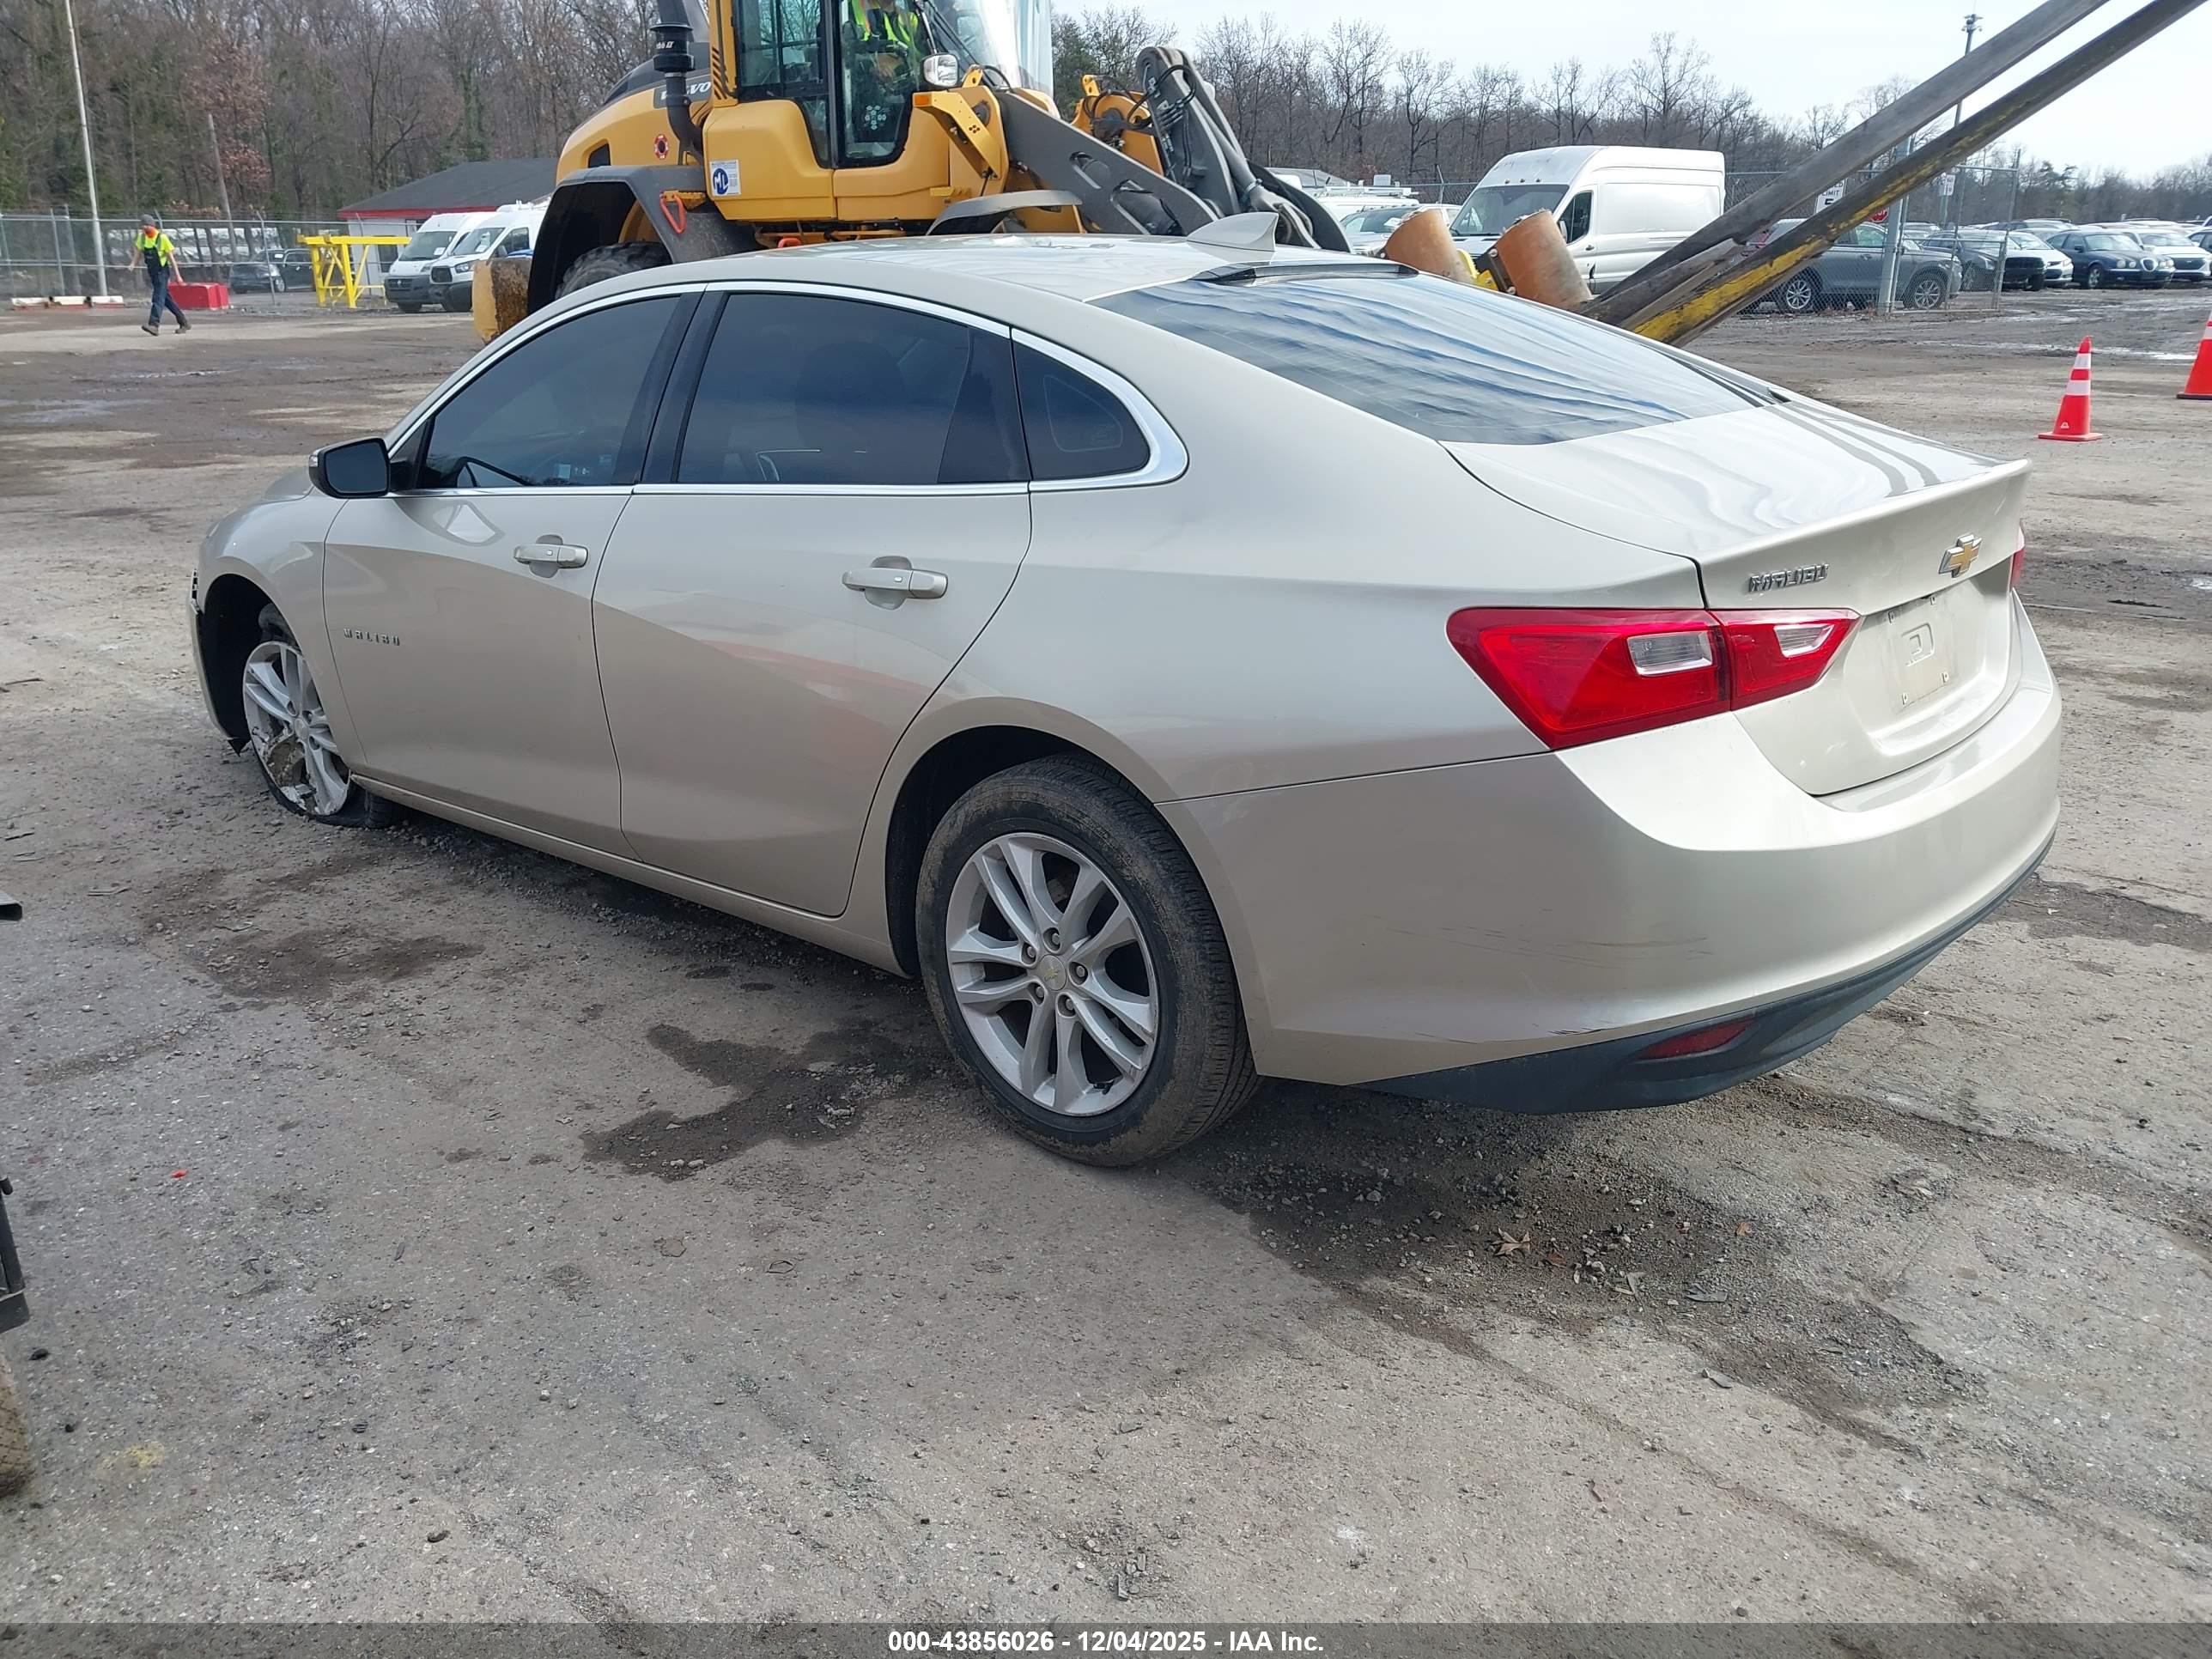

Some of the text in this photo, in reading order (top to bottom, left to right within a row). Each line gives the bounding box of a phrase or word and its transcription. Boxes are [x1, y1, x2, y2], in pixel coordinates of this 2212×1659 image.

[660, 82, 711, 100] VVO
[1748, 563, 1829, 592] MALIBU
[343, 628, 400, 646] MALIBU
